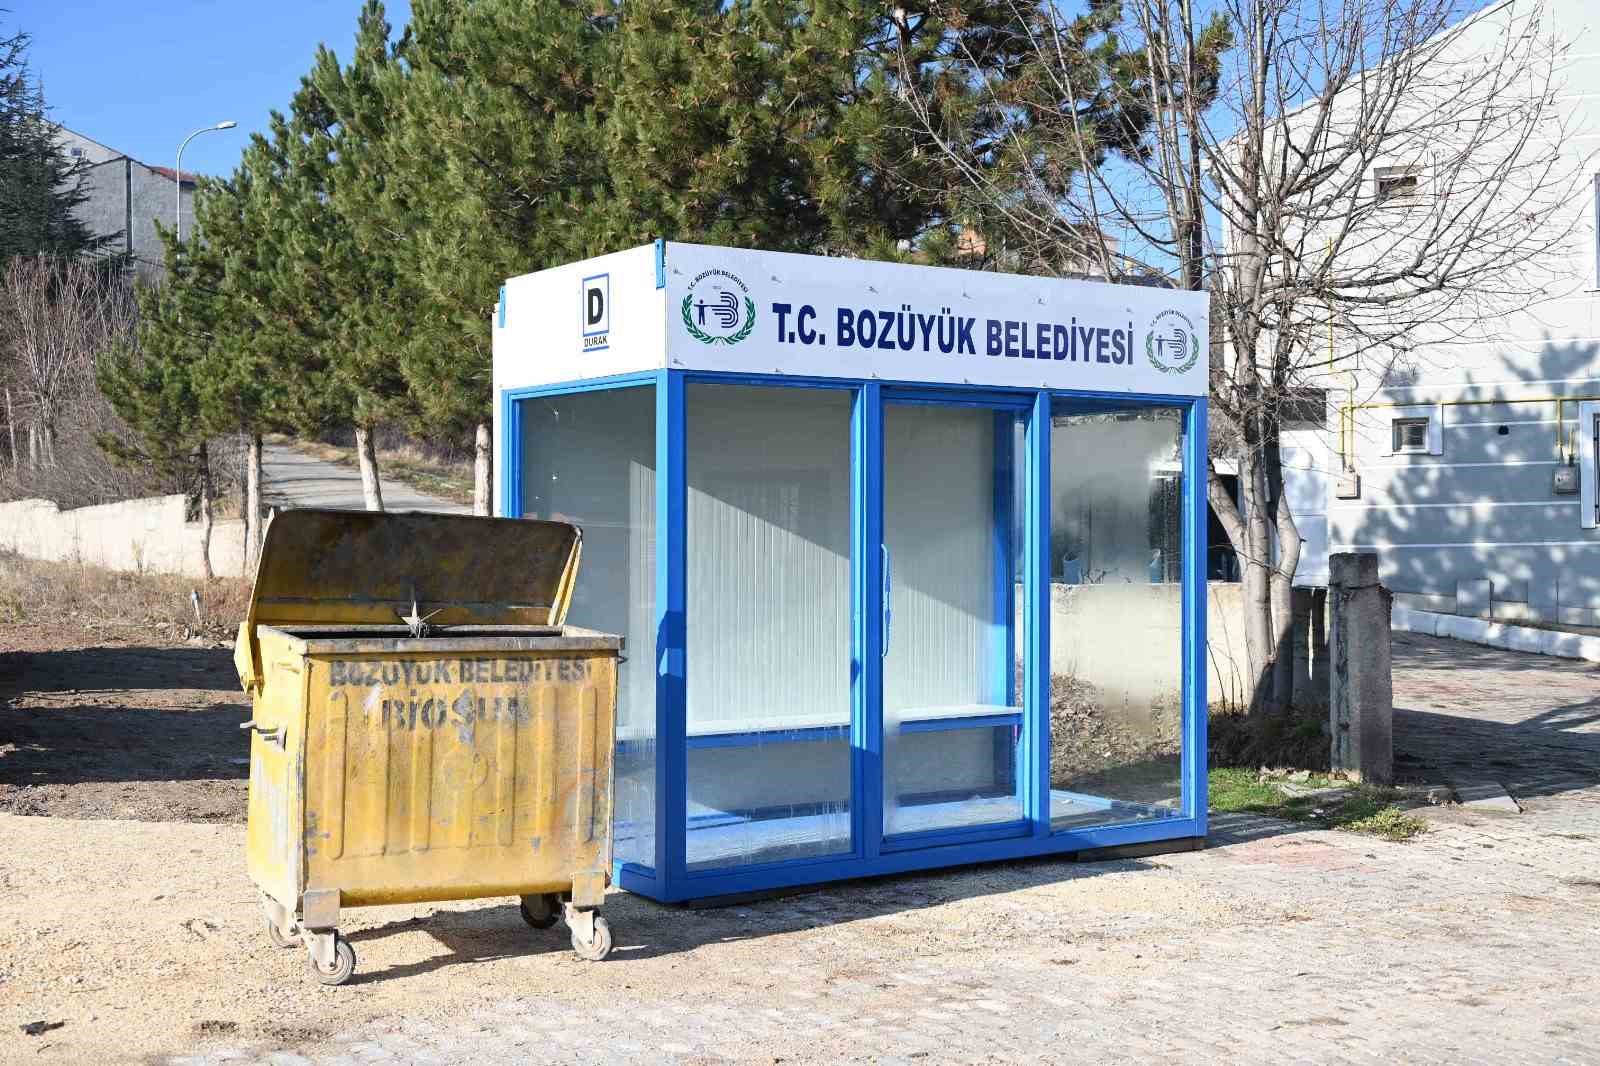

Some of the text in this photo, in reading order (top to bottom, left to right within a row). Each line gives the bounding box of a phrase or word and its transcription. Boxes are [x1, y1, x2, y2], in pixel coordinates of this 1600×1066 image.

[587, 287, 604, 326] D
[583, 335, 608, 348] DURAK
[772, 302, 826, 345] T.C.
[837, 303, 977, 355] BOZÜYÜK
[986, 316, 1134, 365] BELEDİYESİ
